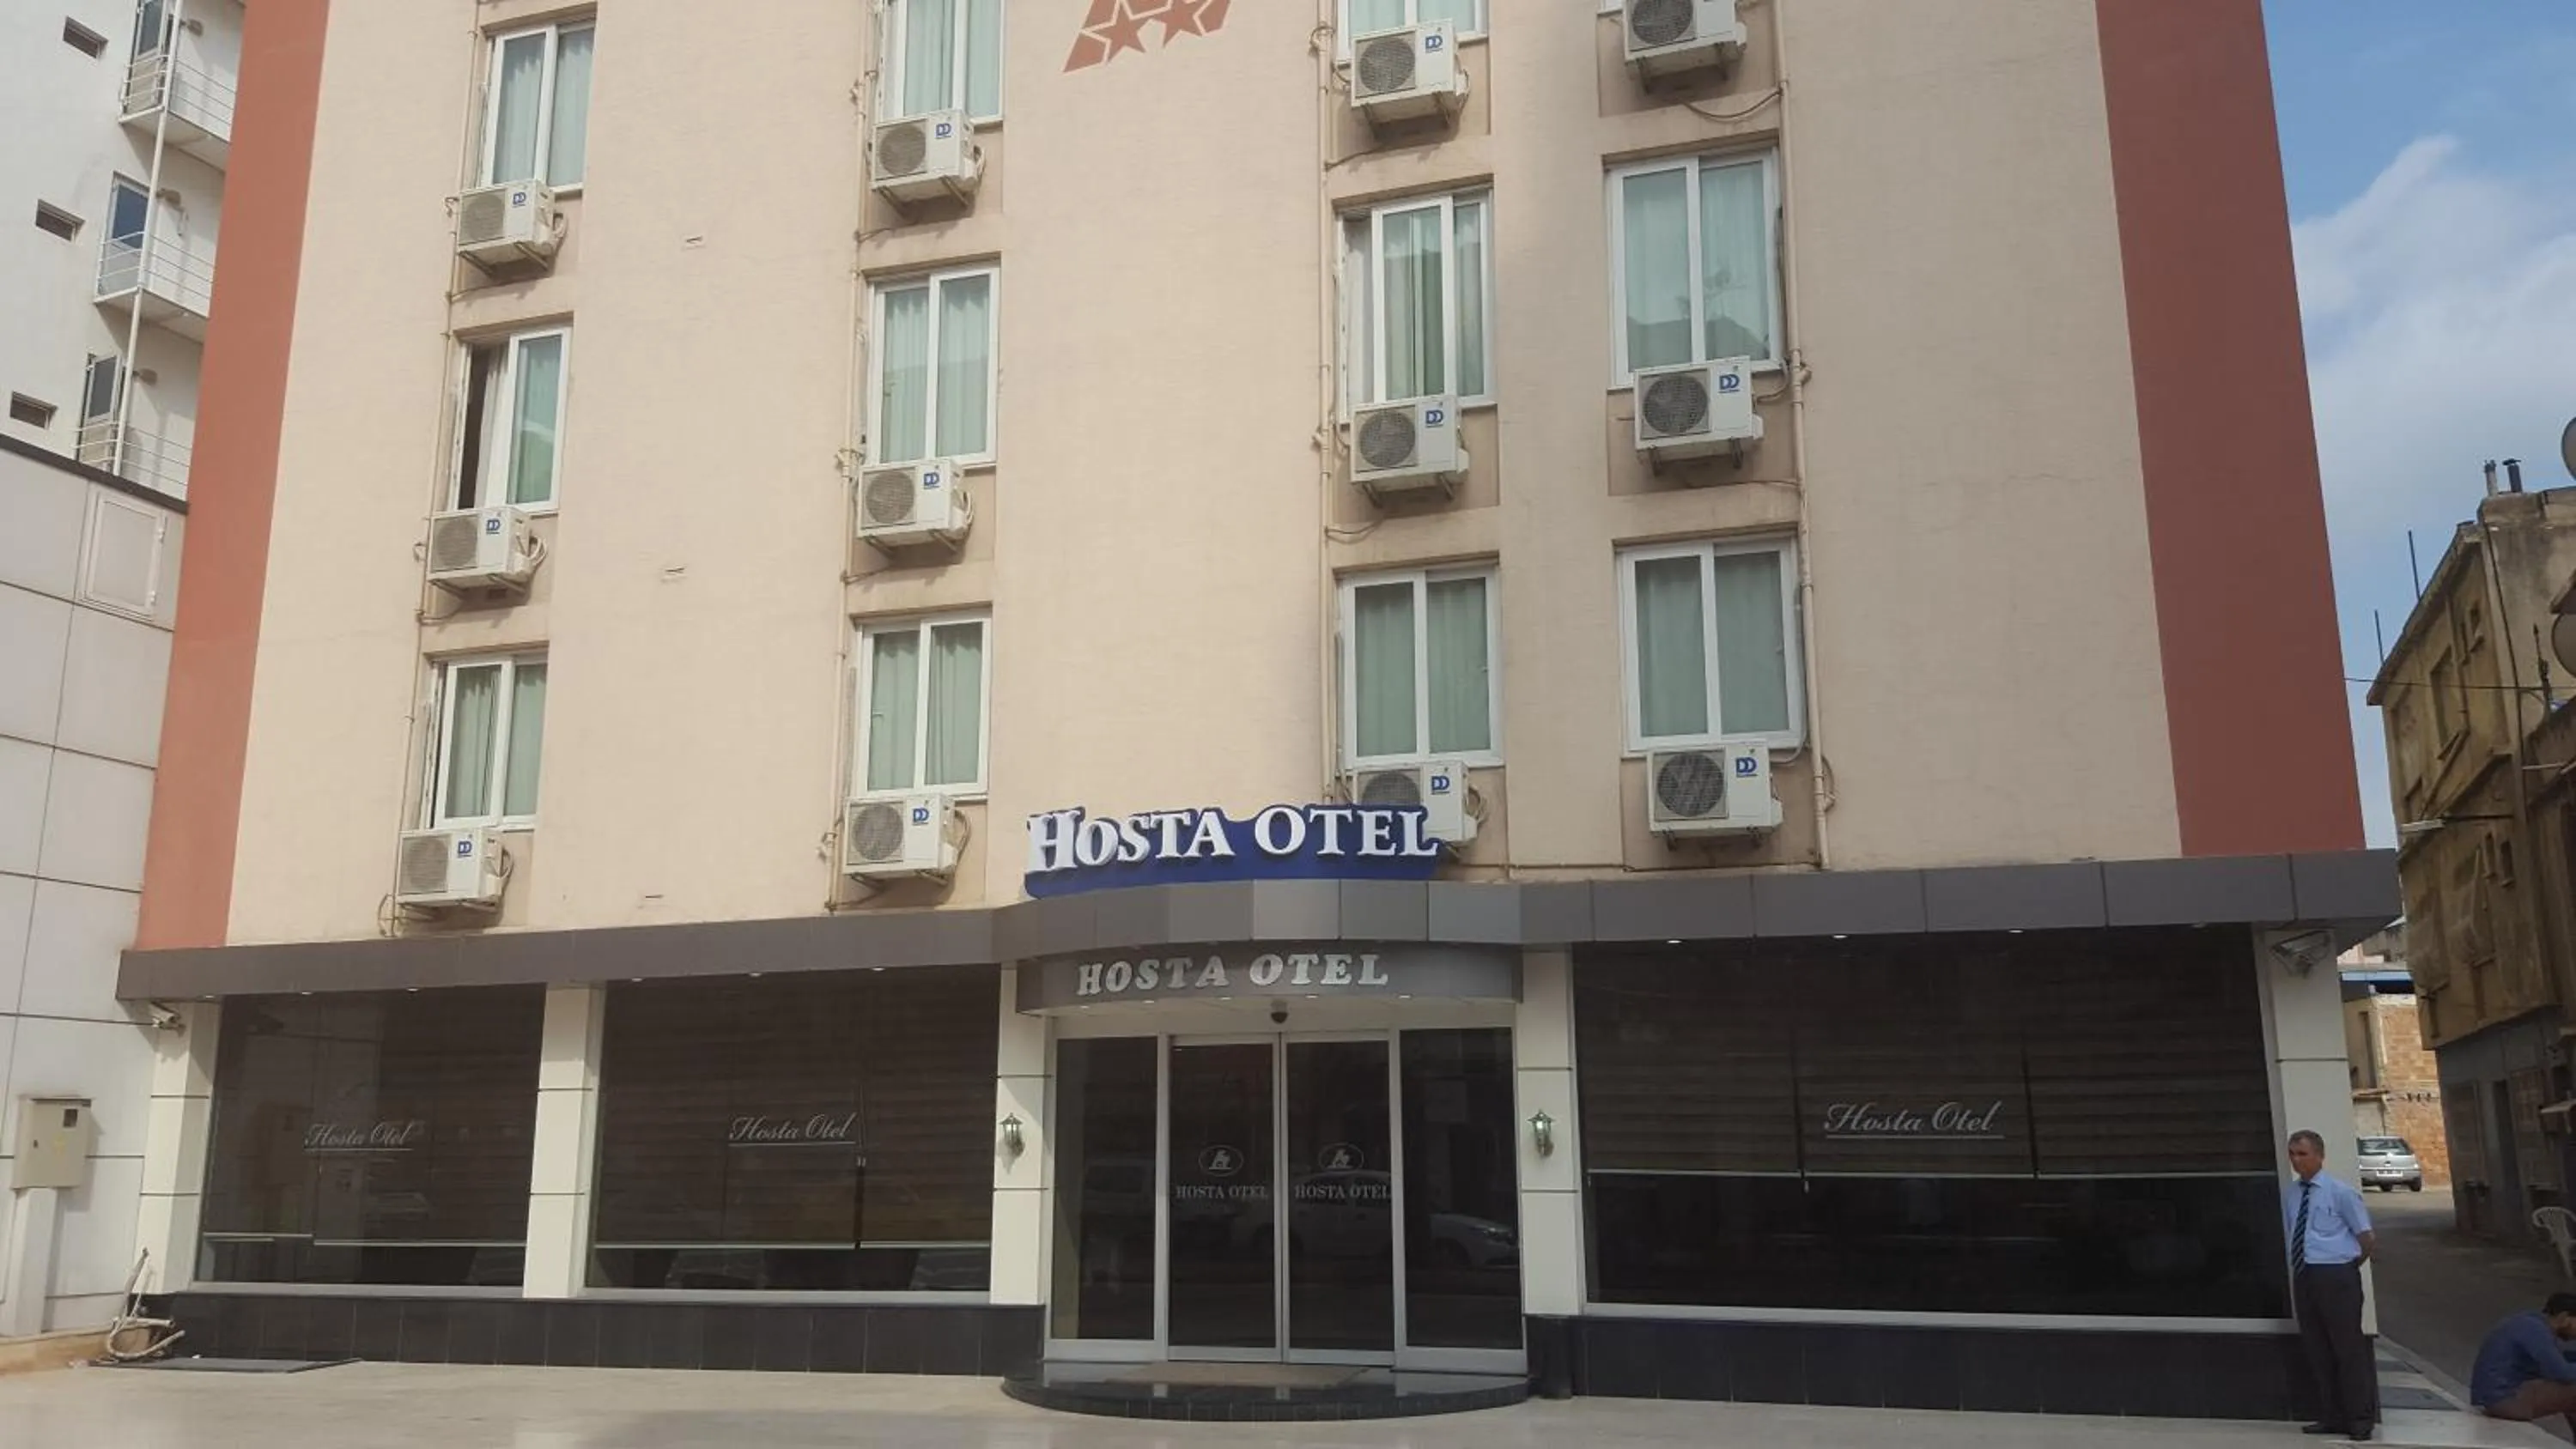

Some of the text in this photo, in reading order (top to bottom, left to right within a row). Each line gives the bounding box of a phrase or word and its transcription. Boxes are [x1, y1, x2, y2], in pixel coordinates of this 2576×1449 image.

[1028, 805, 1439, 873] HOSTA OTEL
[1076, 954, 1388, 997] HOSTA OTEL
[729, 1112, 857, 1140] Hosta Otel
[1824, 1100, 2002, 1131] Hosta Otel
[303, 1119, 414, 1145] Hosta Otel
[1176, 1185, 1268, 1200] HOSTA OTEL
[1294, 1183, 1391, 1199] HOSTA OTEL
